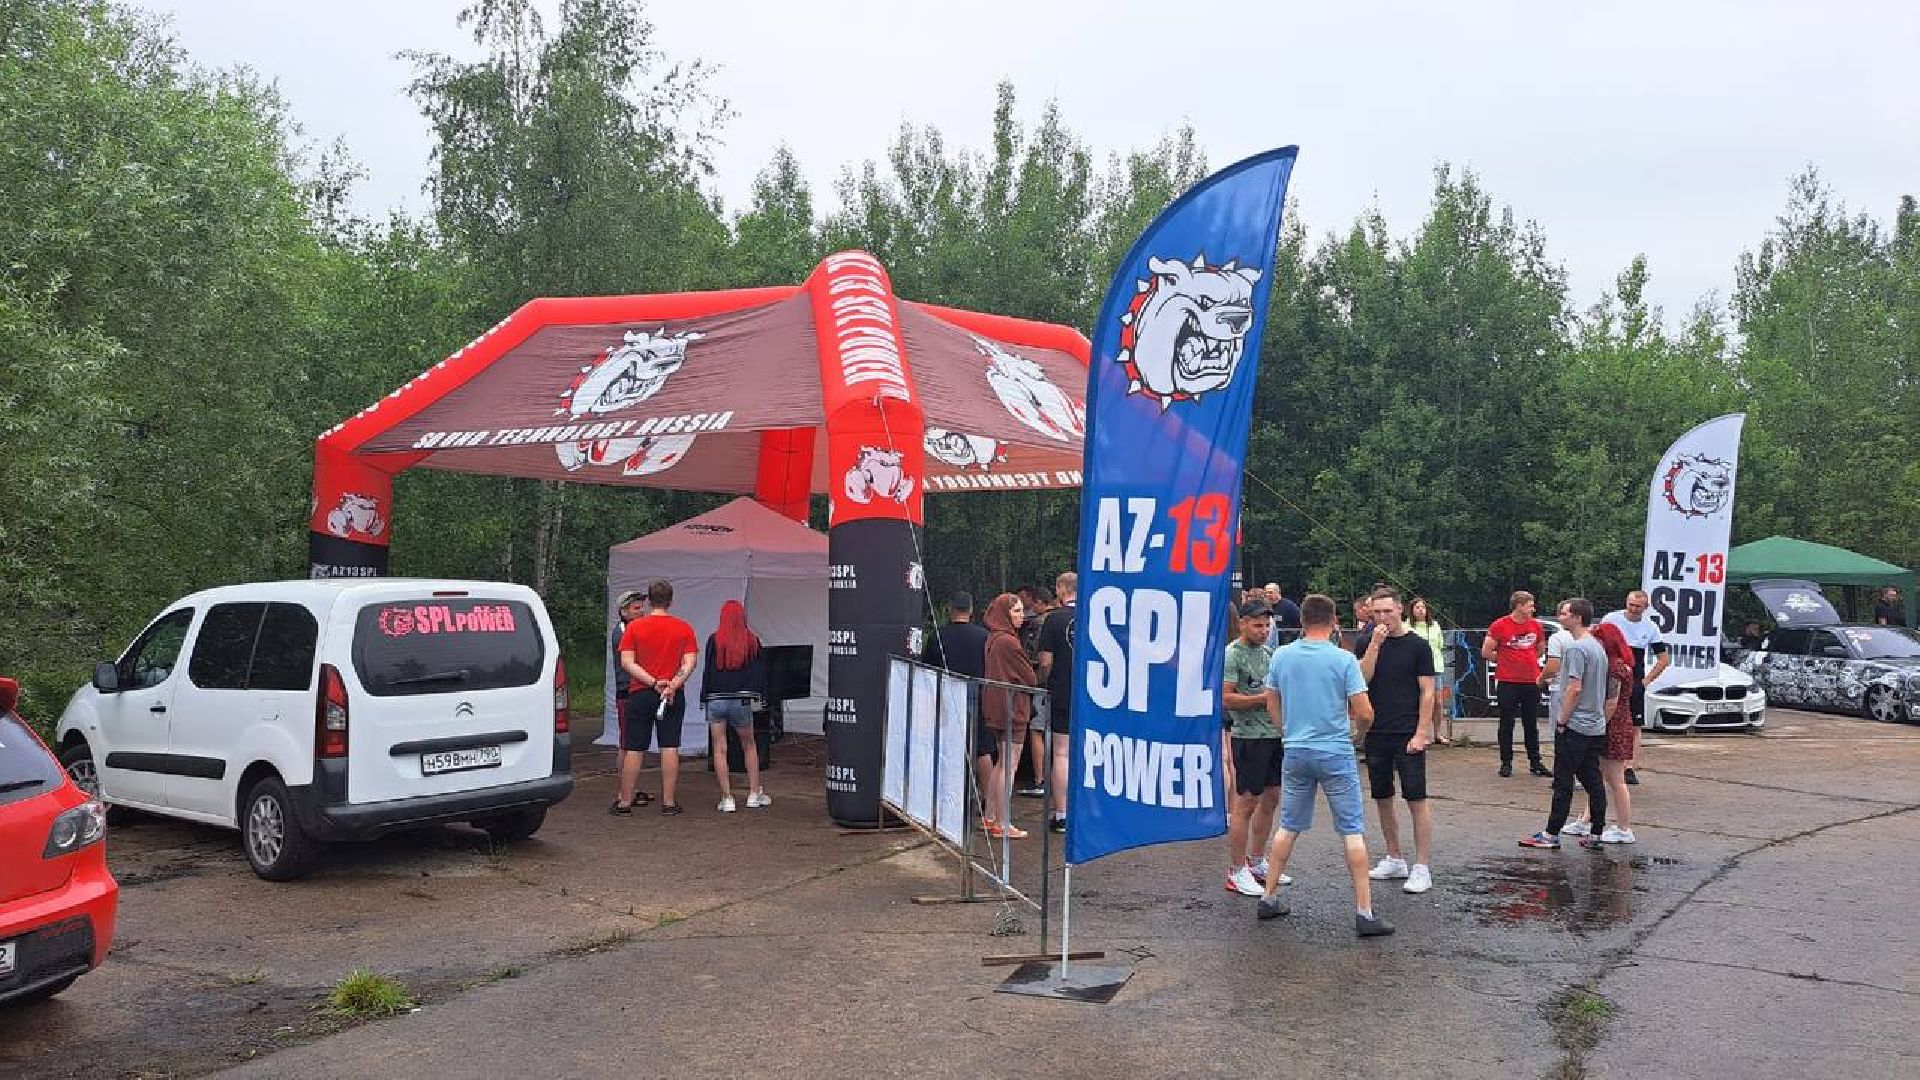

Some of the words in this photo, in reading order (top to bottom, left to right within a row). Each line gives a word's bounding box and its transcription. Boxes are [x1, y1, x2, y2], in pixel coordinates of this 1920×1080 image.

[412, 431, 490, 448] SOUND
[489, 420, 636, 444] TECHNOLOGY
[636, 411, 734, 435] RUSSIA
[1092, 492, 1231, 576] AZ-13
[1652, 550, 1725, 584] AZ-13
[1650, 586, 1718, 636] SPL
[1086, 585, 1213, 717] SPL
[1084, 729, 1213, 808] POWER
